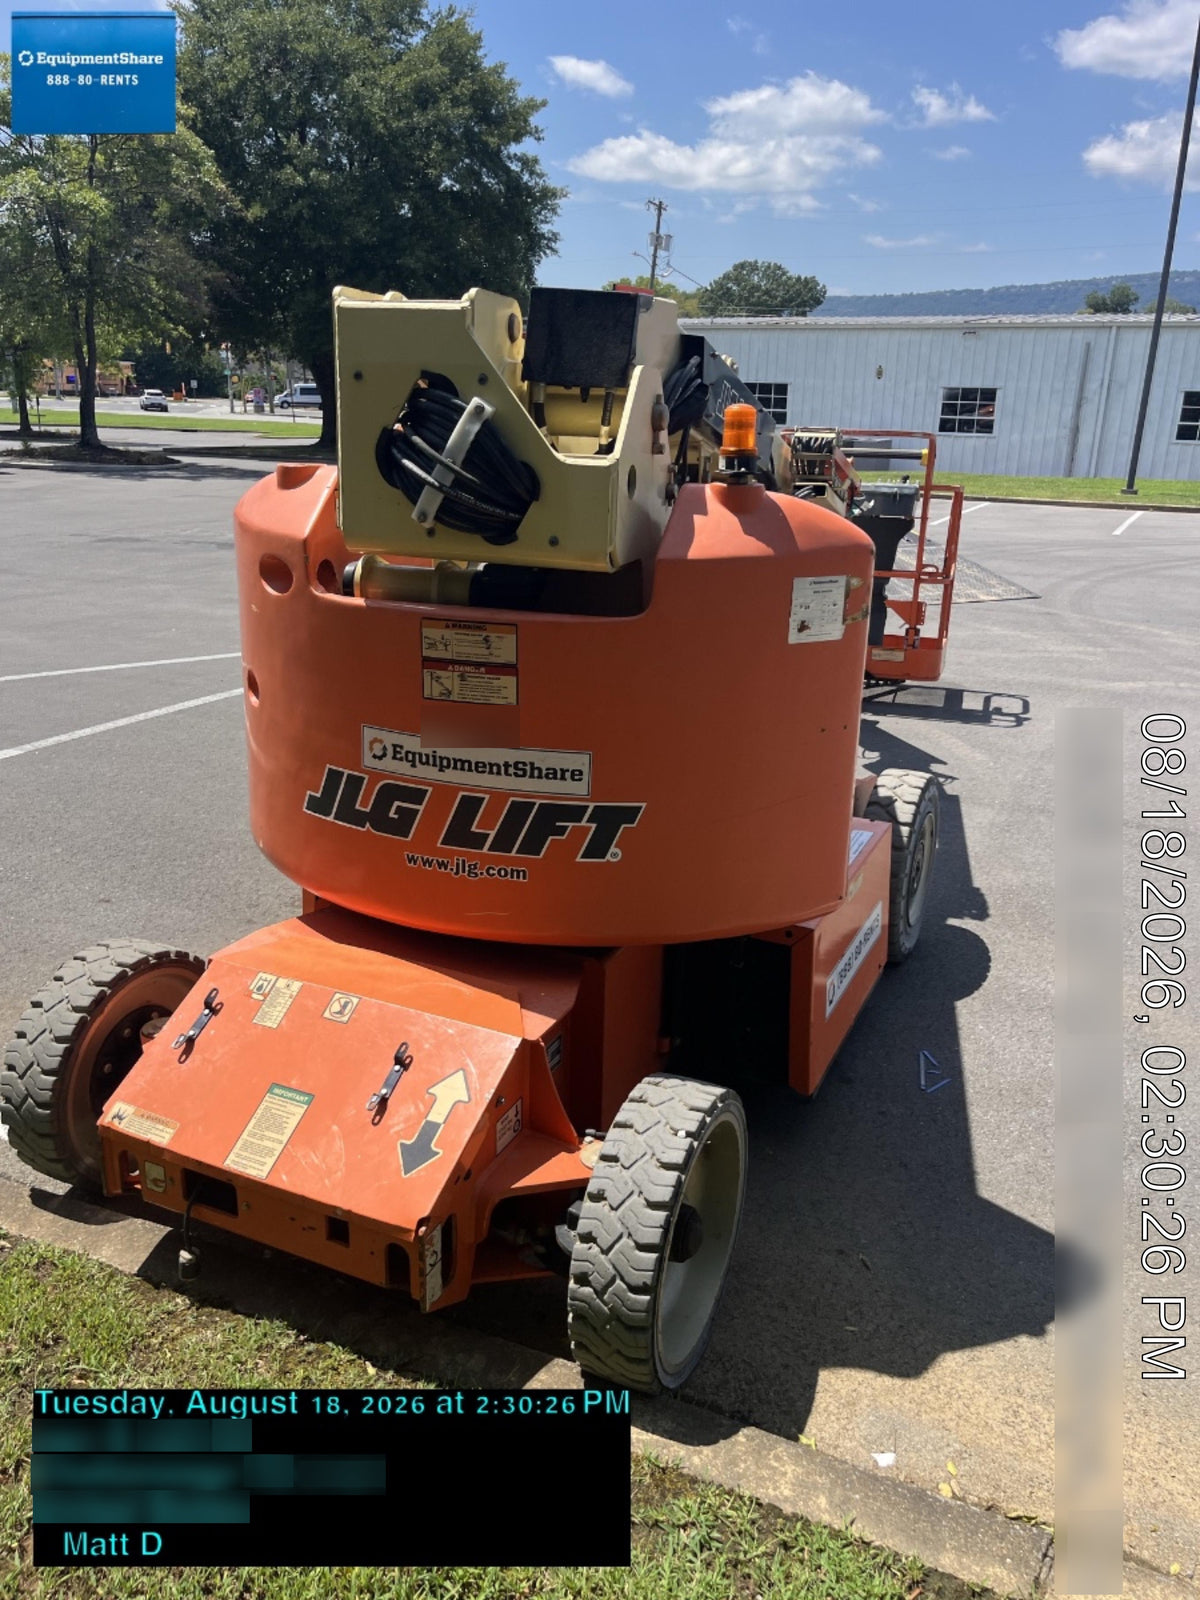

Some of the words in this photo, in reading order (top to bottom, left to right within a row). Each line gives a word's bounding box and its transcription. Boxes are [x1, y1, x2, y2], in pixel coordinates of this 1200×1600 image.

[391, 743, 584, 783] EquipmentShare
[303, 764, 433, 840] JLG
[404, 852, 528, 881] www.jlg.com
